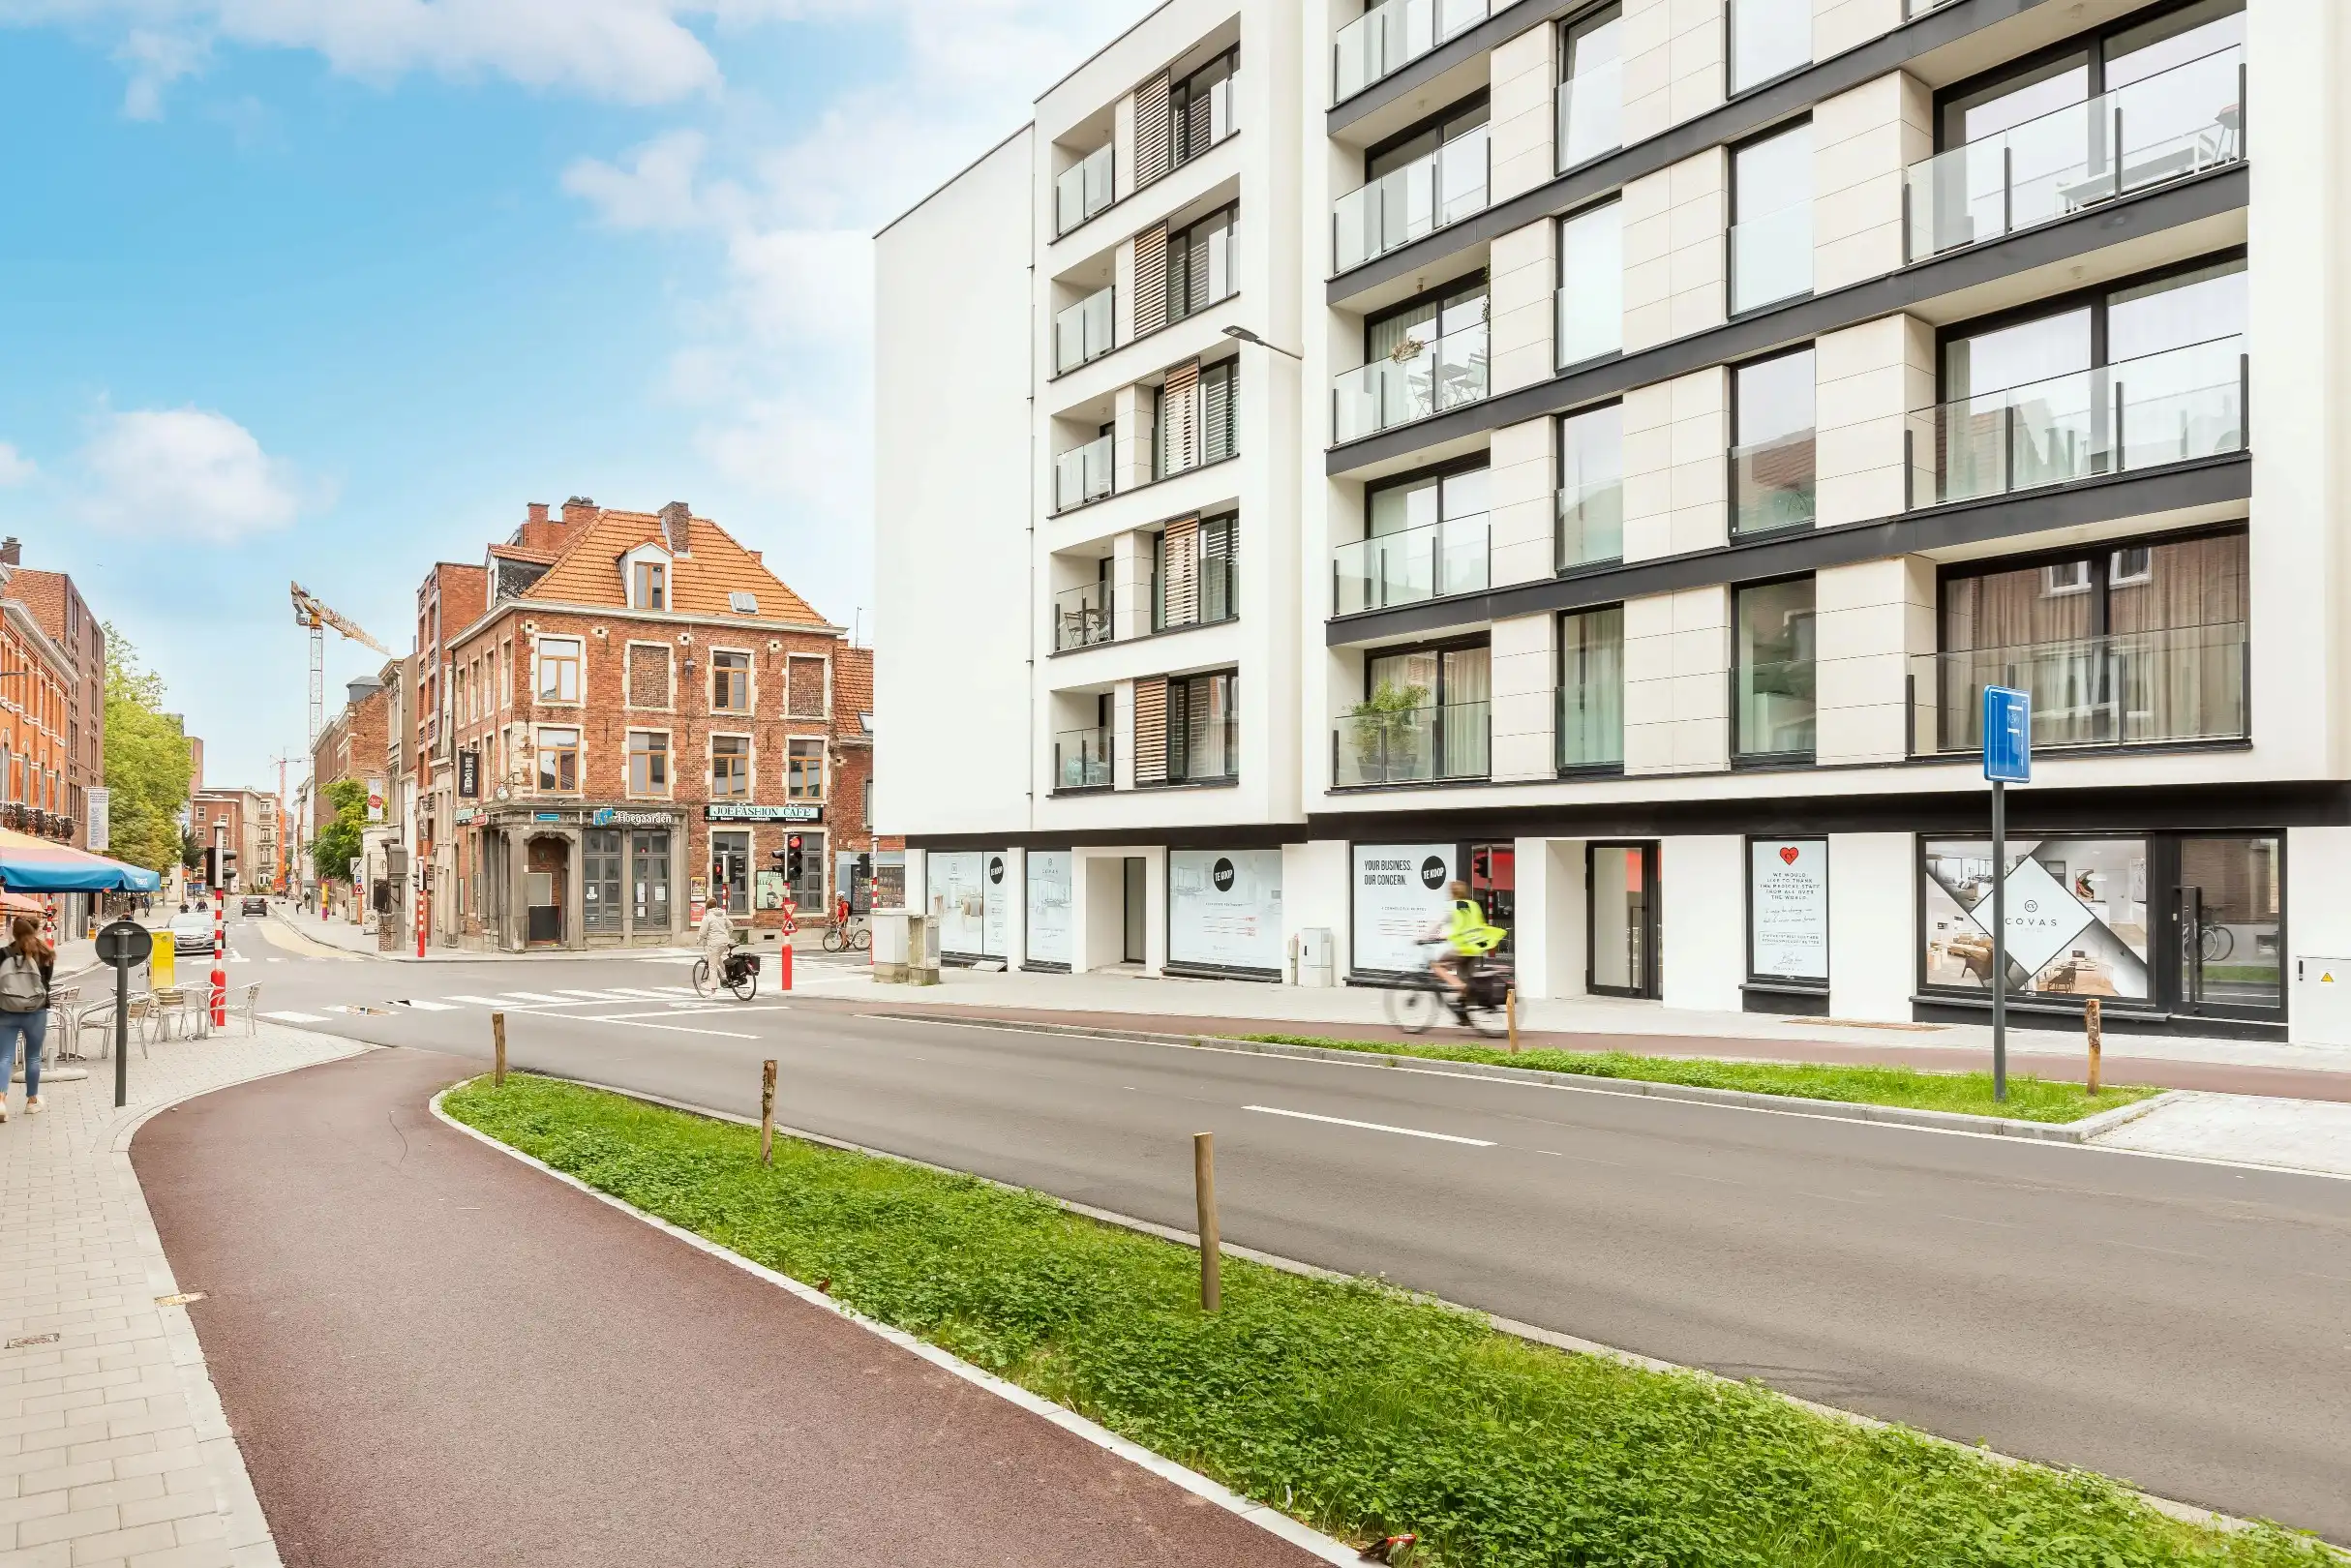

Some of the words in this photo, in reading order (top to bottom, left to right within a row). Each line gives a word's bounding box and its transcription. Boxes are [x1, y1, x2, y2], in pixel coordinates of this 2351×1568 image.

[616, 811, 672, 826] Hoegaarden
[1364, 859, 1380, 871] YOUR
[1380, 859, 1413, 871] BUSINESS.
[1215, 872, 1221, 882] TE
[1221, 869, 1233, 880] KOOP
[1430, 867, 1444, 878] KOOP
[1364, 874, 1376, 885] OUR
[1376, 874, 1407, 886] CONCERN.
[2004, 918, 2057, 926] COVAS
